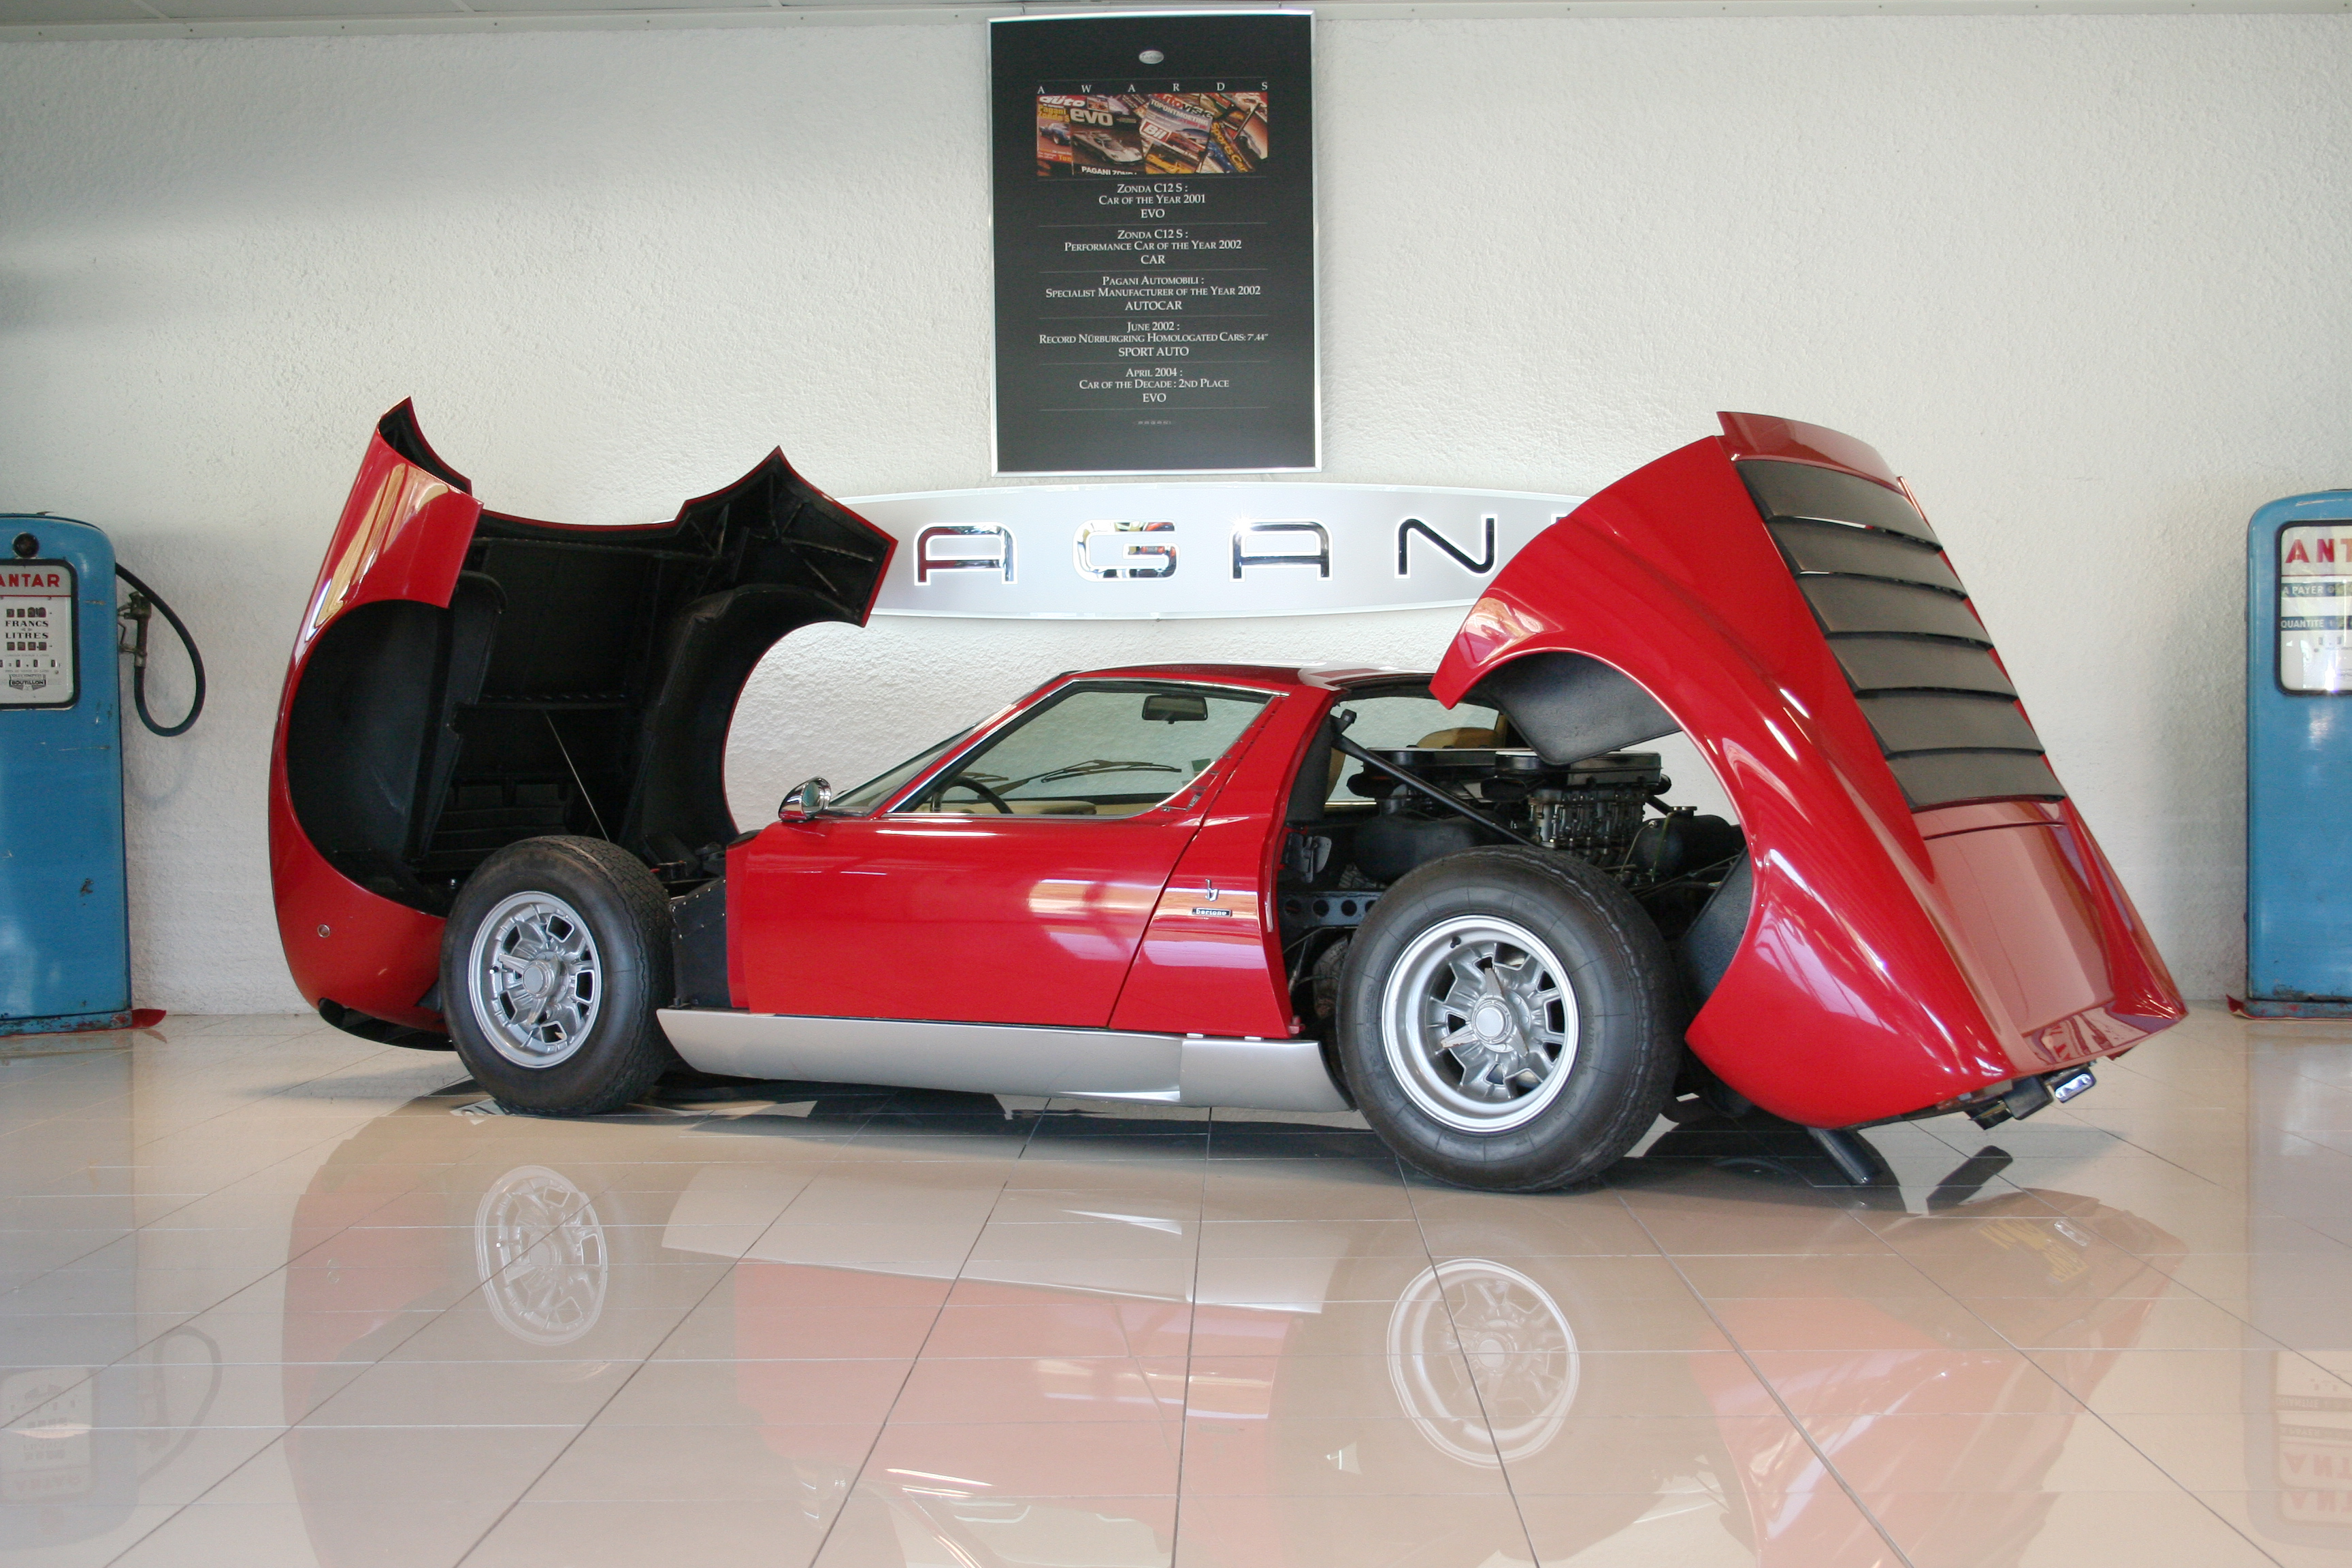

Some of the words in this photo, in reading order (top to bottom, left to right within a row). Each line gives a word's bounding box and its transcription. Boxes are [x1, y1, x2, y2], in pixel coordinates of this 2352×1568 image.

[1070, 108, 1113, 126] evo
[1144, 124, 1167, 140] Bil
[1081, 166, 1111, 175] PAGANI
[1117, 184, 1151, 193] ZONDA
[1154, 183, 1173, 193] C12
[1099, 195, 1119, 205] CAR
[1156, 195, 1181, 203] YEAR
[1183, 194, 1205, 203] 2001
[1141, 209, 1164, 218] EVO
[1117, 230, 1152, 239] ZONDA
[1154, 229, 1174, 238] C12
[1065, 242, 1131, 251] PERFORMANCE
[1134, 241, 1154, 250] CAR
[1192, 240, 1216, 249] YEAR
[1219, 240, 1241, 248] 2002
[1141, 255, 1165, 264] CAR
[1102, 276, 1138, 285] PAGANI
[1141, 276, 1198, 284] AUTOMOBILI
[1046, 289, 1096, 297] SPECIALIST
[1098, 288, 1173, 297] MANUFACTURER
[1211, 287, 1235, 295] YEAR
[1238, 286, 1260, 295] 2002
[1125, 301, 1182, 310] AUTOCAR
[1127, 322, 1149, 333] JUNE
[1152, 322, 1174, 330] 2002
[1040, 335, 1076, 344] RECORD
[1147, 333, 1218, 342] HOMOLOGATED
[1119, 347, 1154, 357] SPORT
[1156, 347, 1189, 356] AUTO
[1126, 368, 1153, 377] APRIL
[1155, 368, 1177, 376] 2004
[1079, 380, 1099, 389] CAR
[1135, 379, 1172, 388] DECADE
[1179, 379, 1198, 387] 2ND
[1200, 378, 1229, 387] PLACE
[1143, 393, 1166, 402] EVO
[914, 513, 1567, 586] AGAN
[2292, 585, 2323, 594] PAYER
